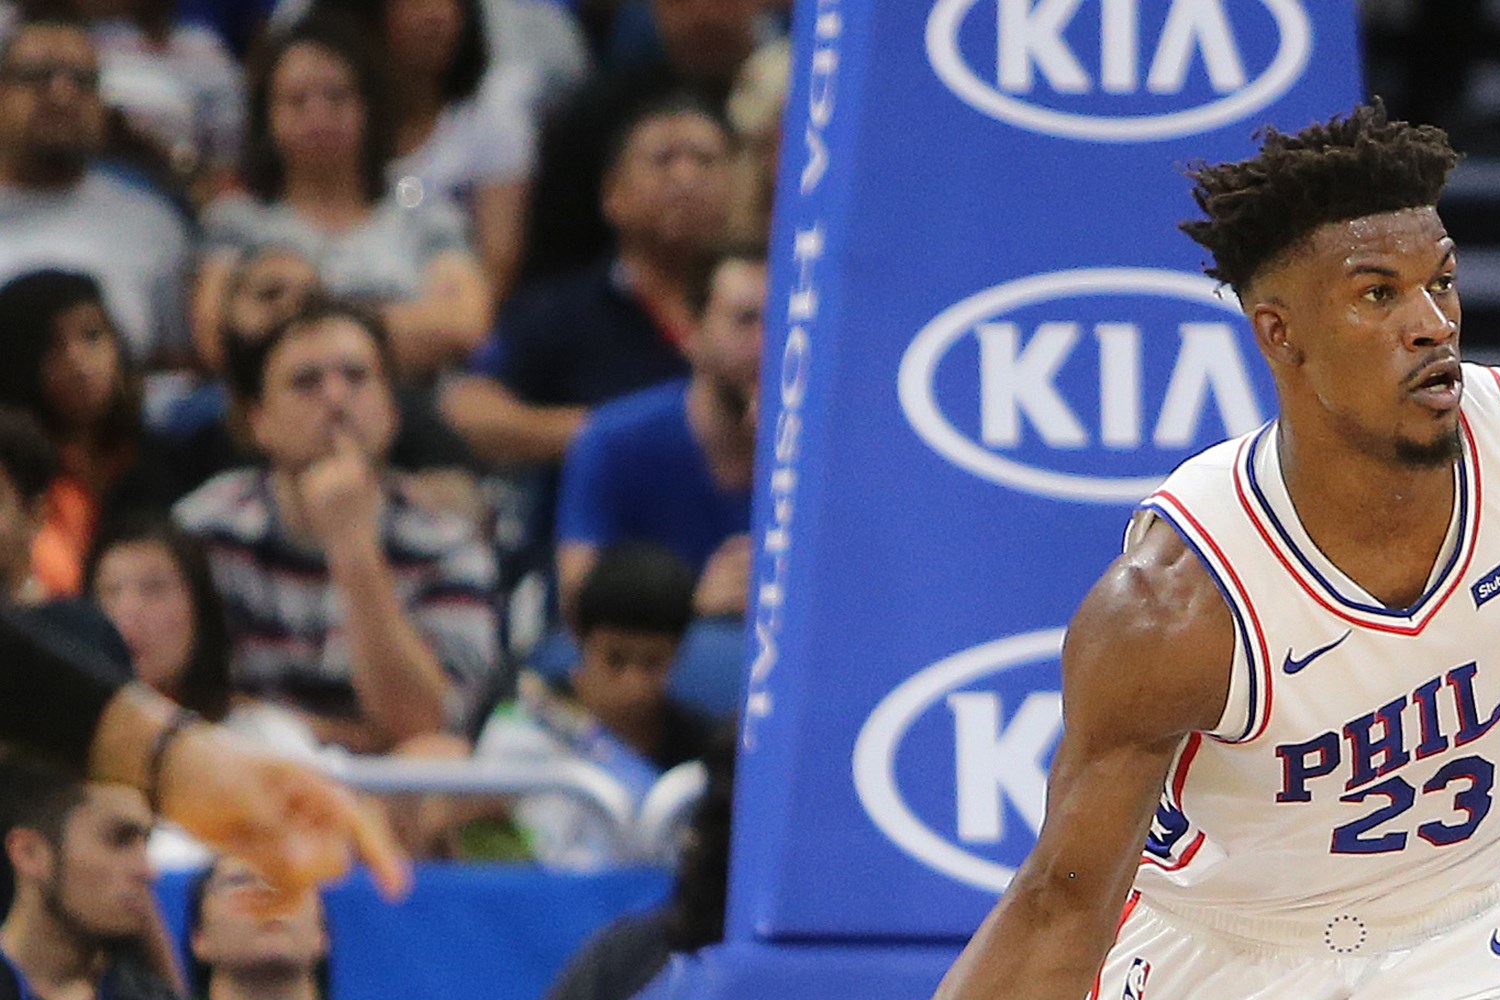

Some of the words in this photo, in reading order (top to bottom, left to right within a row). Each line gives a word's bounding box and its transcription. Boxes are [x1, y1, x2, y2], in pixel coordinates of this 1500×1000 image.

[995, 0, 1248, 95] KIA
[974, 321, 1264, 449] KIA
[743, 222, 826, 752] HOSPITAL
[1329, 754, 1495, 855] 23
